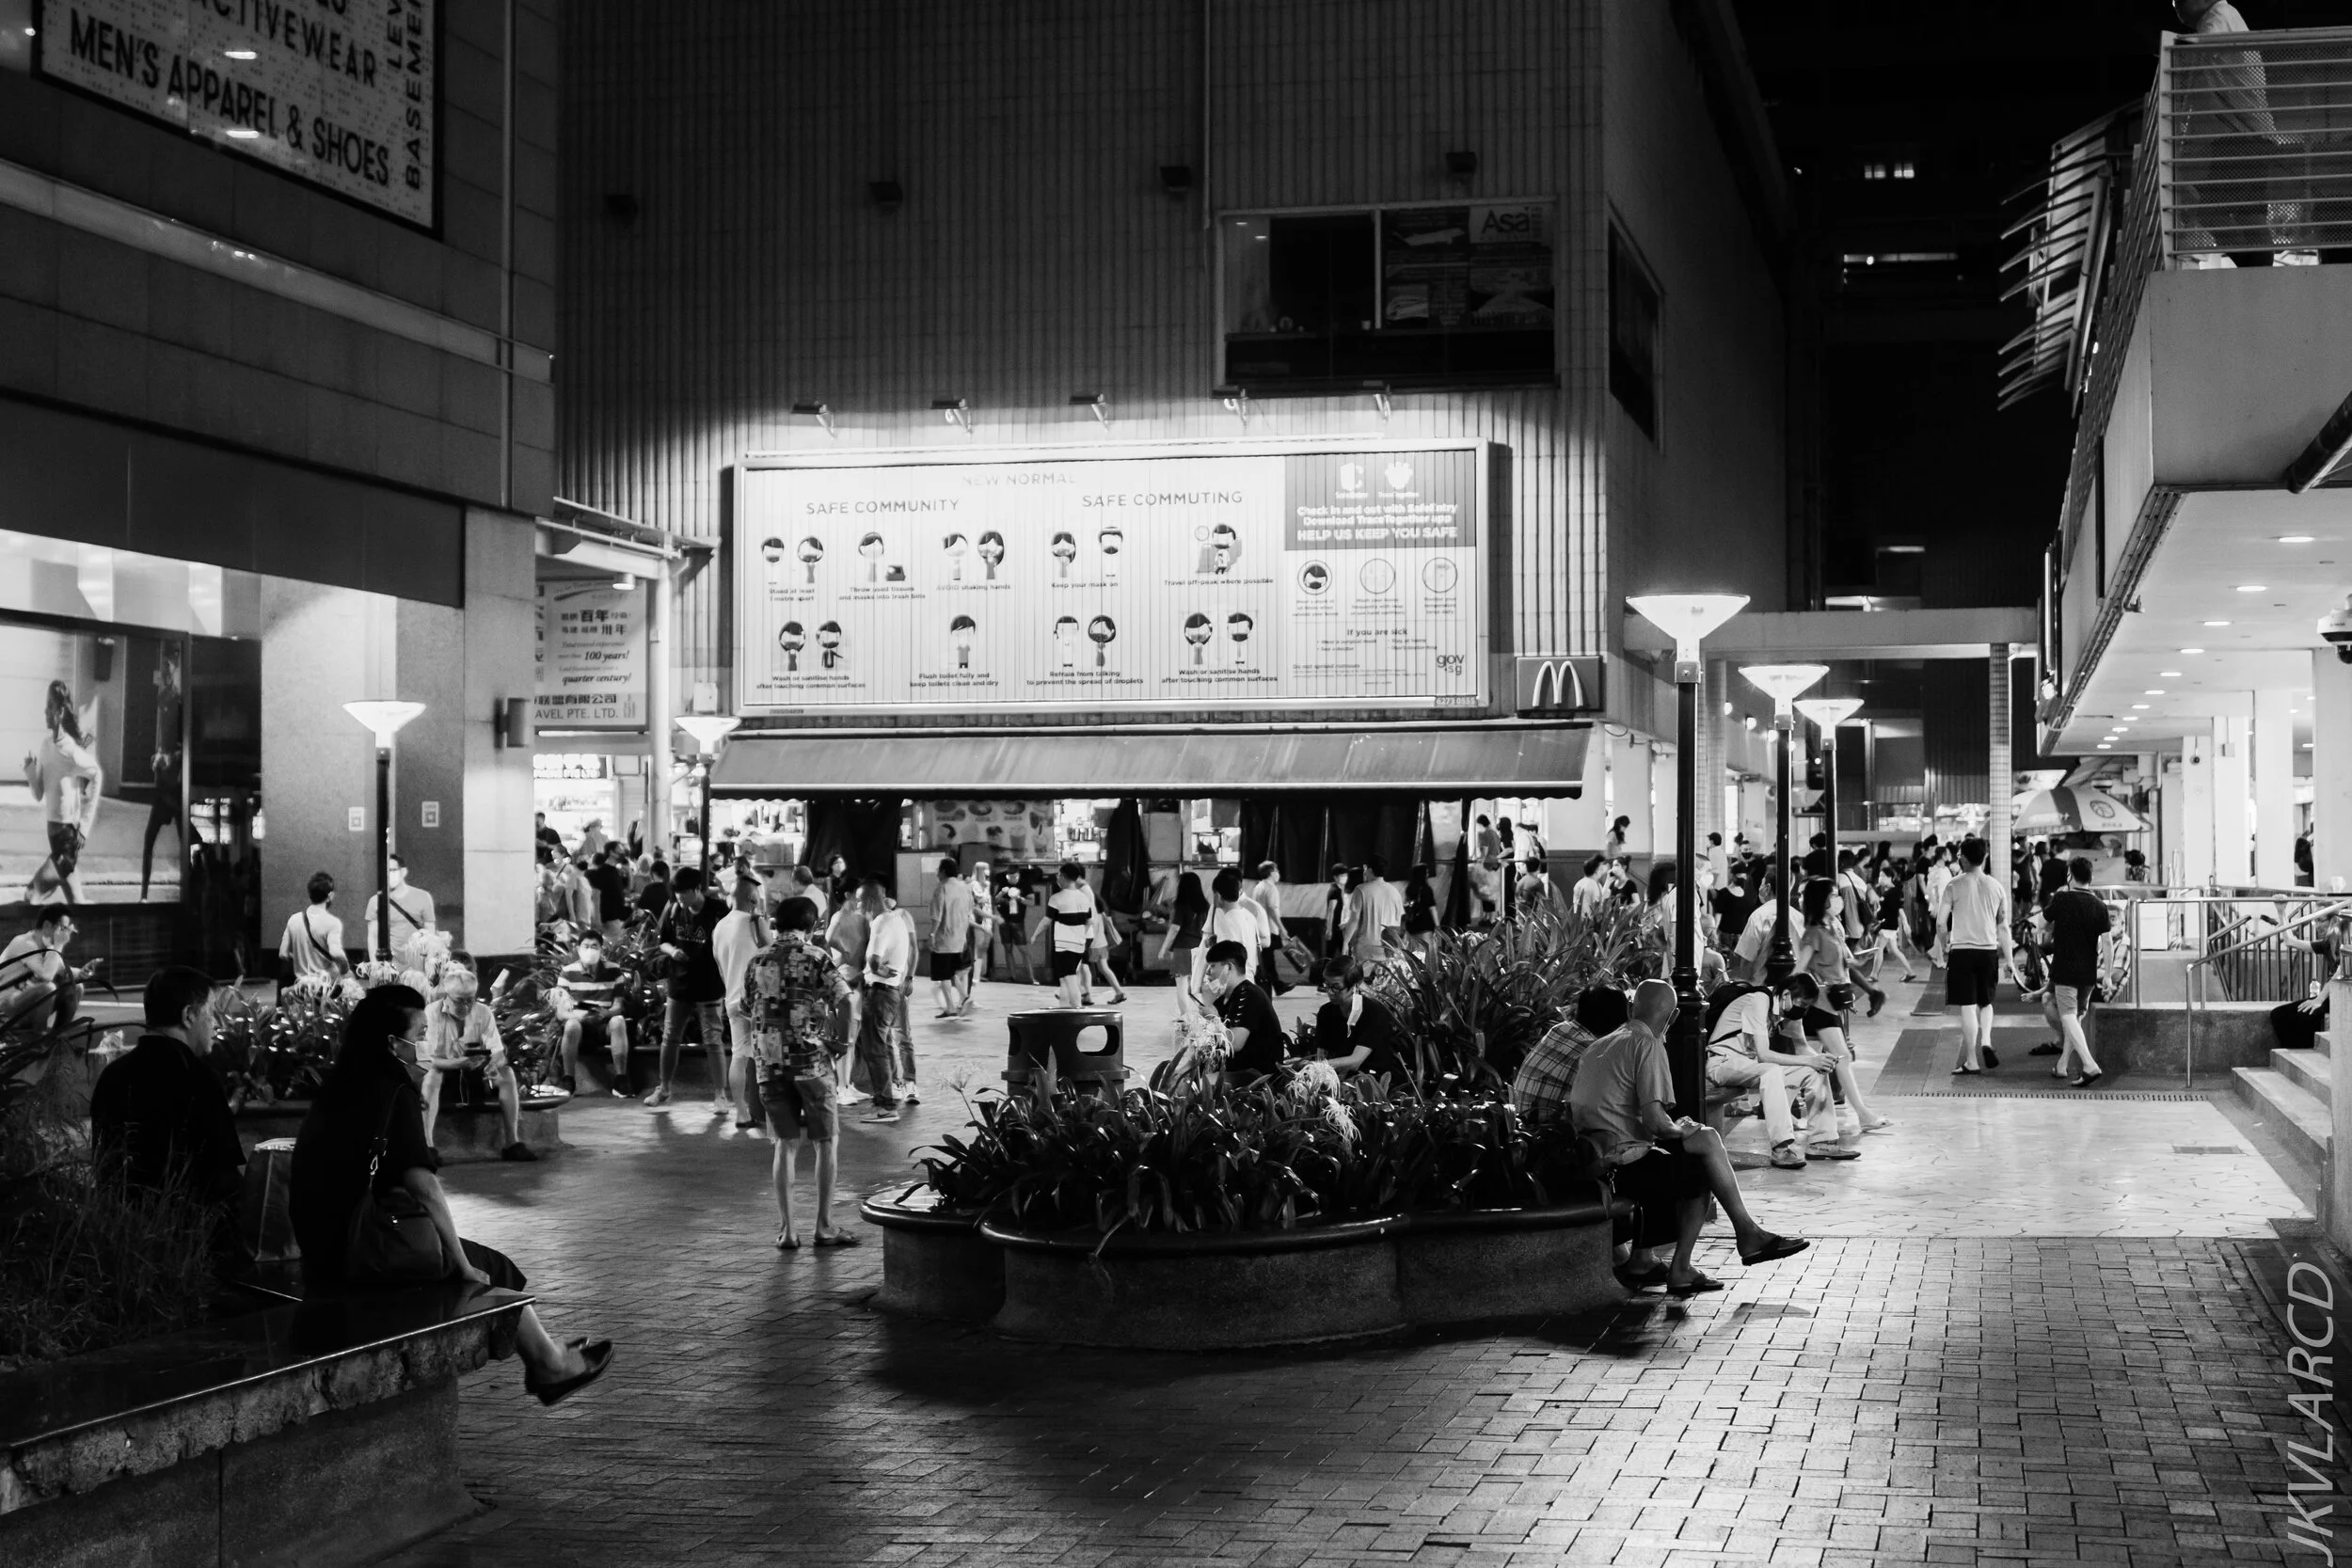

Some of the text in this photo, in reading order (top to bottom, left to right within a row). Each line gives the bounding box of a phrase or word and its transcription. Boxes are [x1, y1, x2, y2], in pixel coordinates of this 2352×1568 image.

[200, 0, 376, 88] TIVEWEAR
[70, 8, 389, 186] MEN'S APPAREL & SHOES
[962, 472, 1077, 486] NEW NORMAL
[1082, 491, 1243, 508] SAFE COMMUTING
[806, 499, 960, 515] SAFE COMMUNITY
[1297, 503, 1458, 516] Check in and out with SafeEntry
[1303, 515, 1355, 526] Download
[1431, 515, 1453, 525] app
[1297, 527, 1458, 542] HELP US KEEP YOU SAFE
[1356, 628, 1372, 638] you
[584, 650, 601, 660] 100
[601, 648, 630, 663] years!
[1437, 655, 1465, 668] gov
[562, 673, 632, 687] quarter century!
[534, 693, 617, 705] 联盟有限公司
[566, 707, 591, 719] PTE.
[594, 706, 618, 719] LTD.
